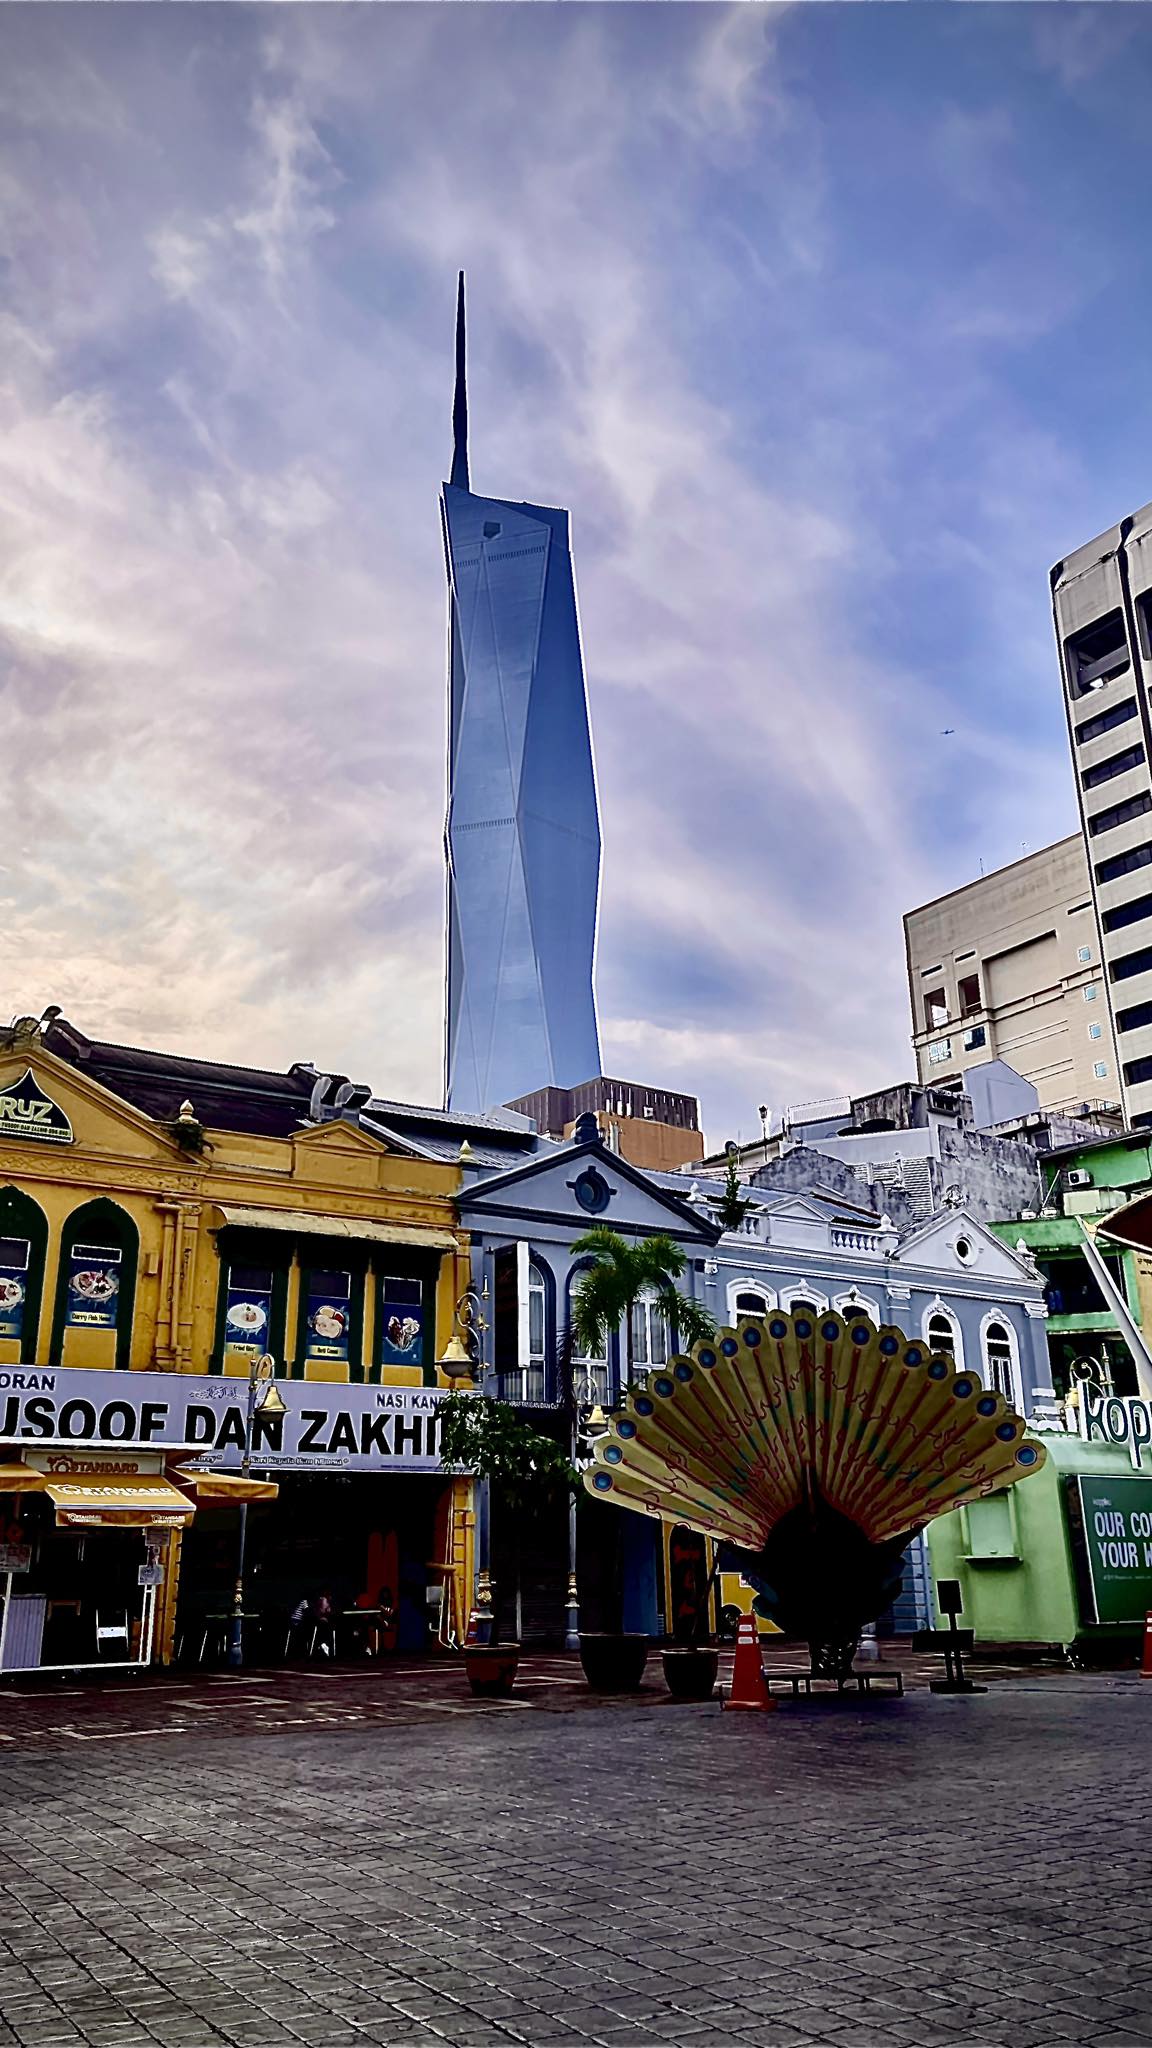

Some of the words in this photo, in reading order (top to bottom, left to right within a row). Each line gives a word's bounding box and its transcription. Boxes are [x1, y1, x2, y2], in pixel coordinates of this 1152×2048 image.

[377, 1393, 407, 1408] NASI
[184, 1404, 284, 1451] DAN
[298, 1410, 444, 1457] ZAKHI
[1094, 1511, 1126, 1538] OUR
[1097, 1541, 1139, 1568] YOUR
